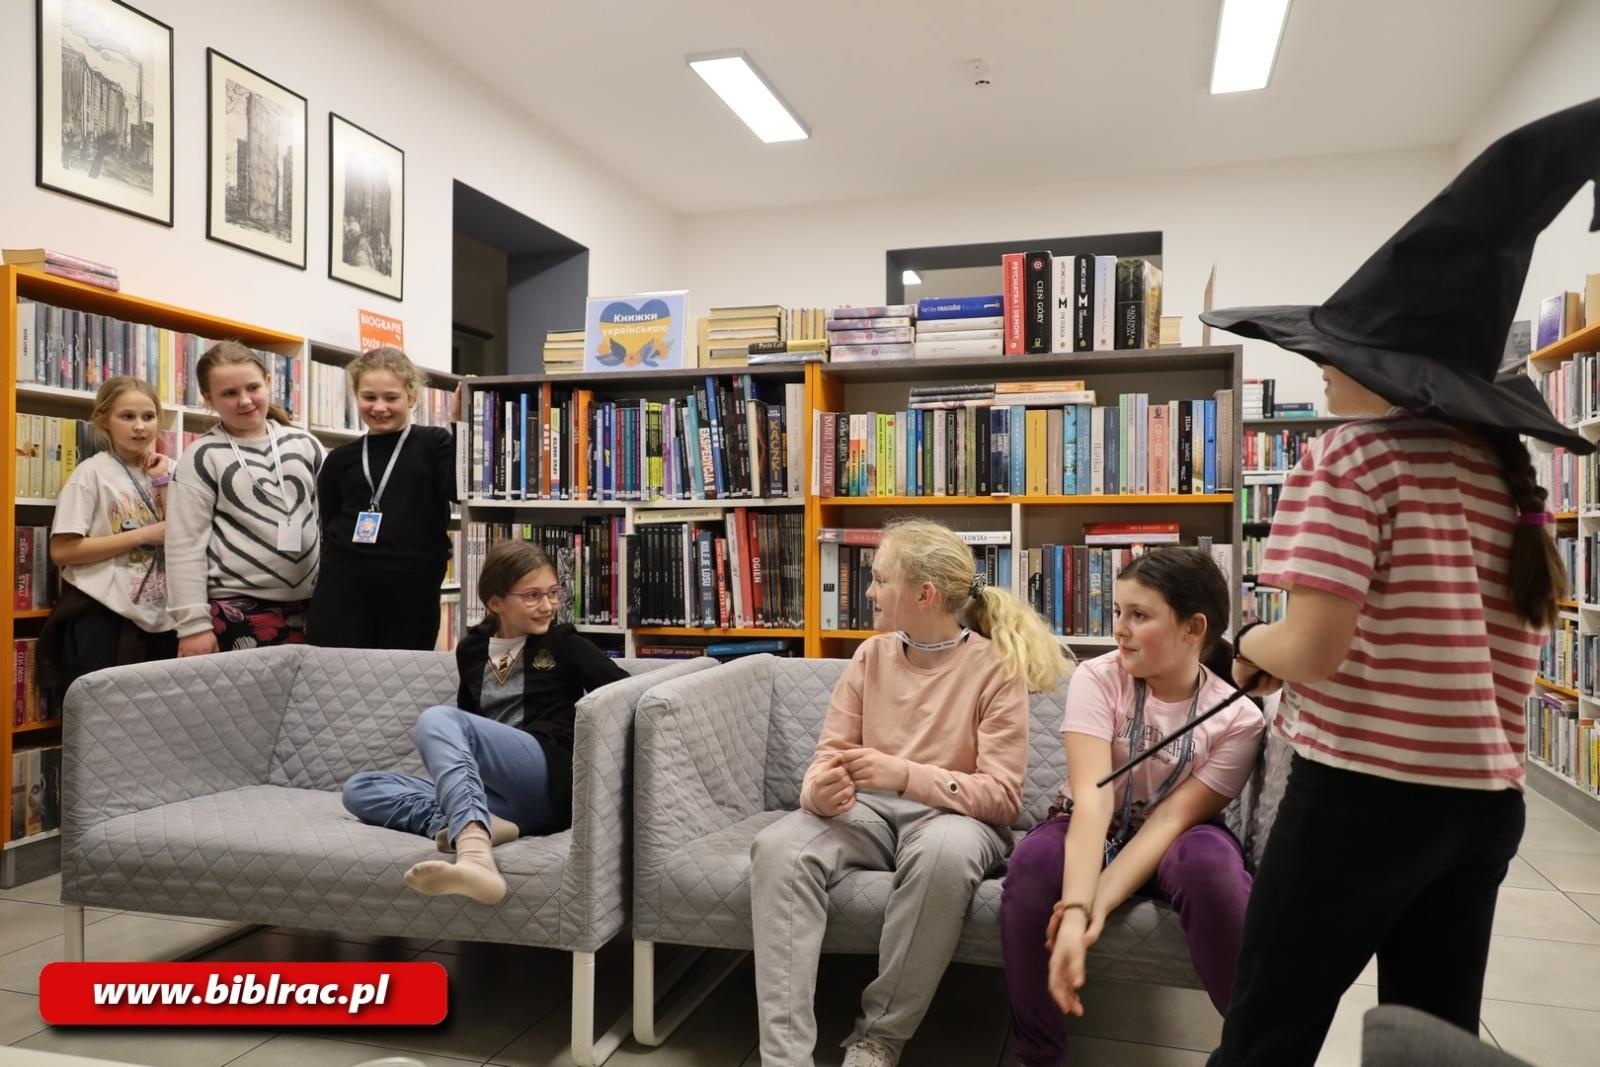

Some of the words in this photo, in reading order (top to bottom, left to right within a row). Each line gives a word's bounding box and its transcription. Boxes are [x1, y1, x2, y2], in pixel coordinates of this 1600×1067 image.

[1036, 280, 1045, 300] CIEŃ
[361, 313, 402, 334] BIOGRAFIE
[613, 313, 658, 323] Книжки
[1036, 302, 1046, 324] GÓRY
[602, 324, 669, 338] українською
[824, 416, 834, 440] ISABEL
[698, 428, 715, 483] EKSPEDYCJA
[769, 419, 780, 481] KACZKI
[824, 453, 834, 486] ALLENDE
[700, 541, 711, 567] KOLEJE
[702, 568, 712, 587] LOSU
